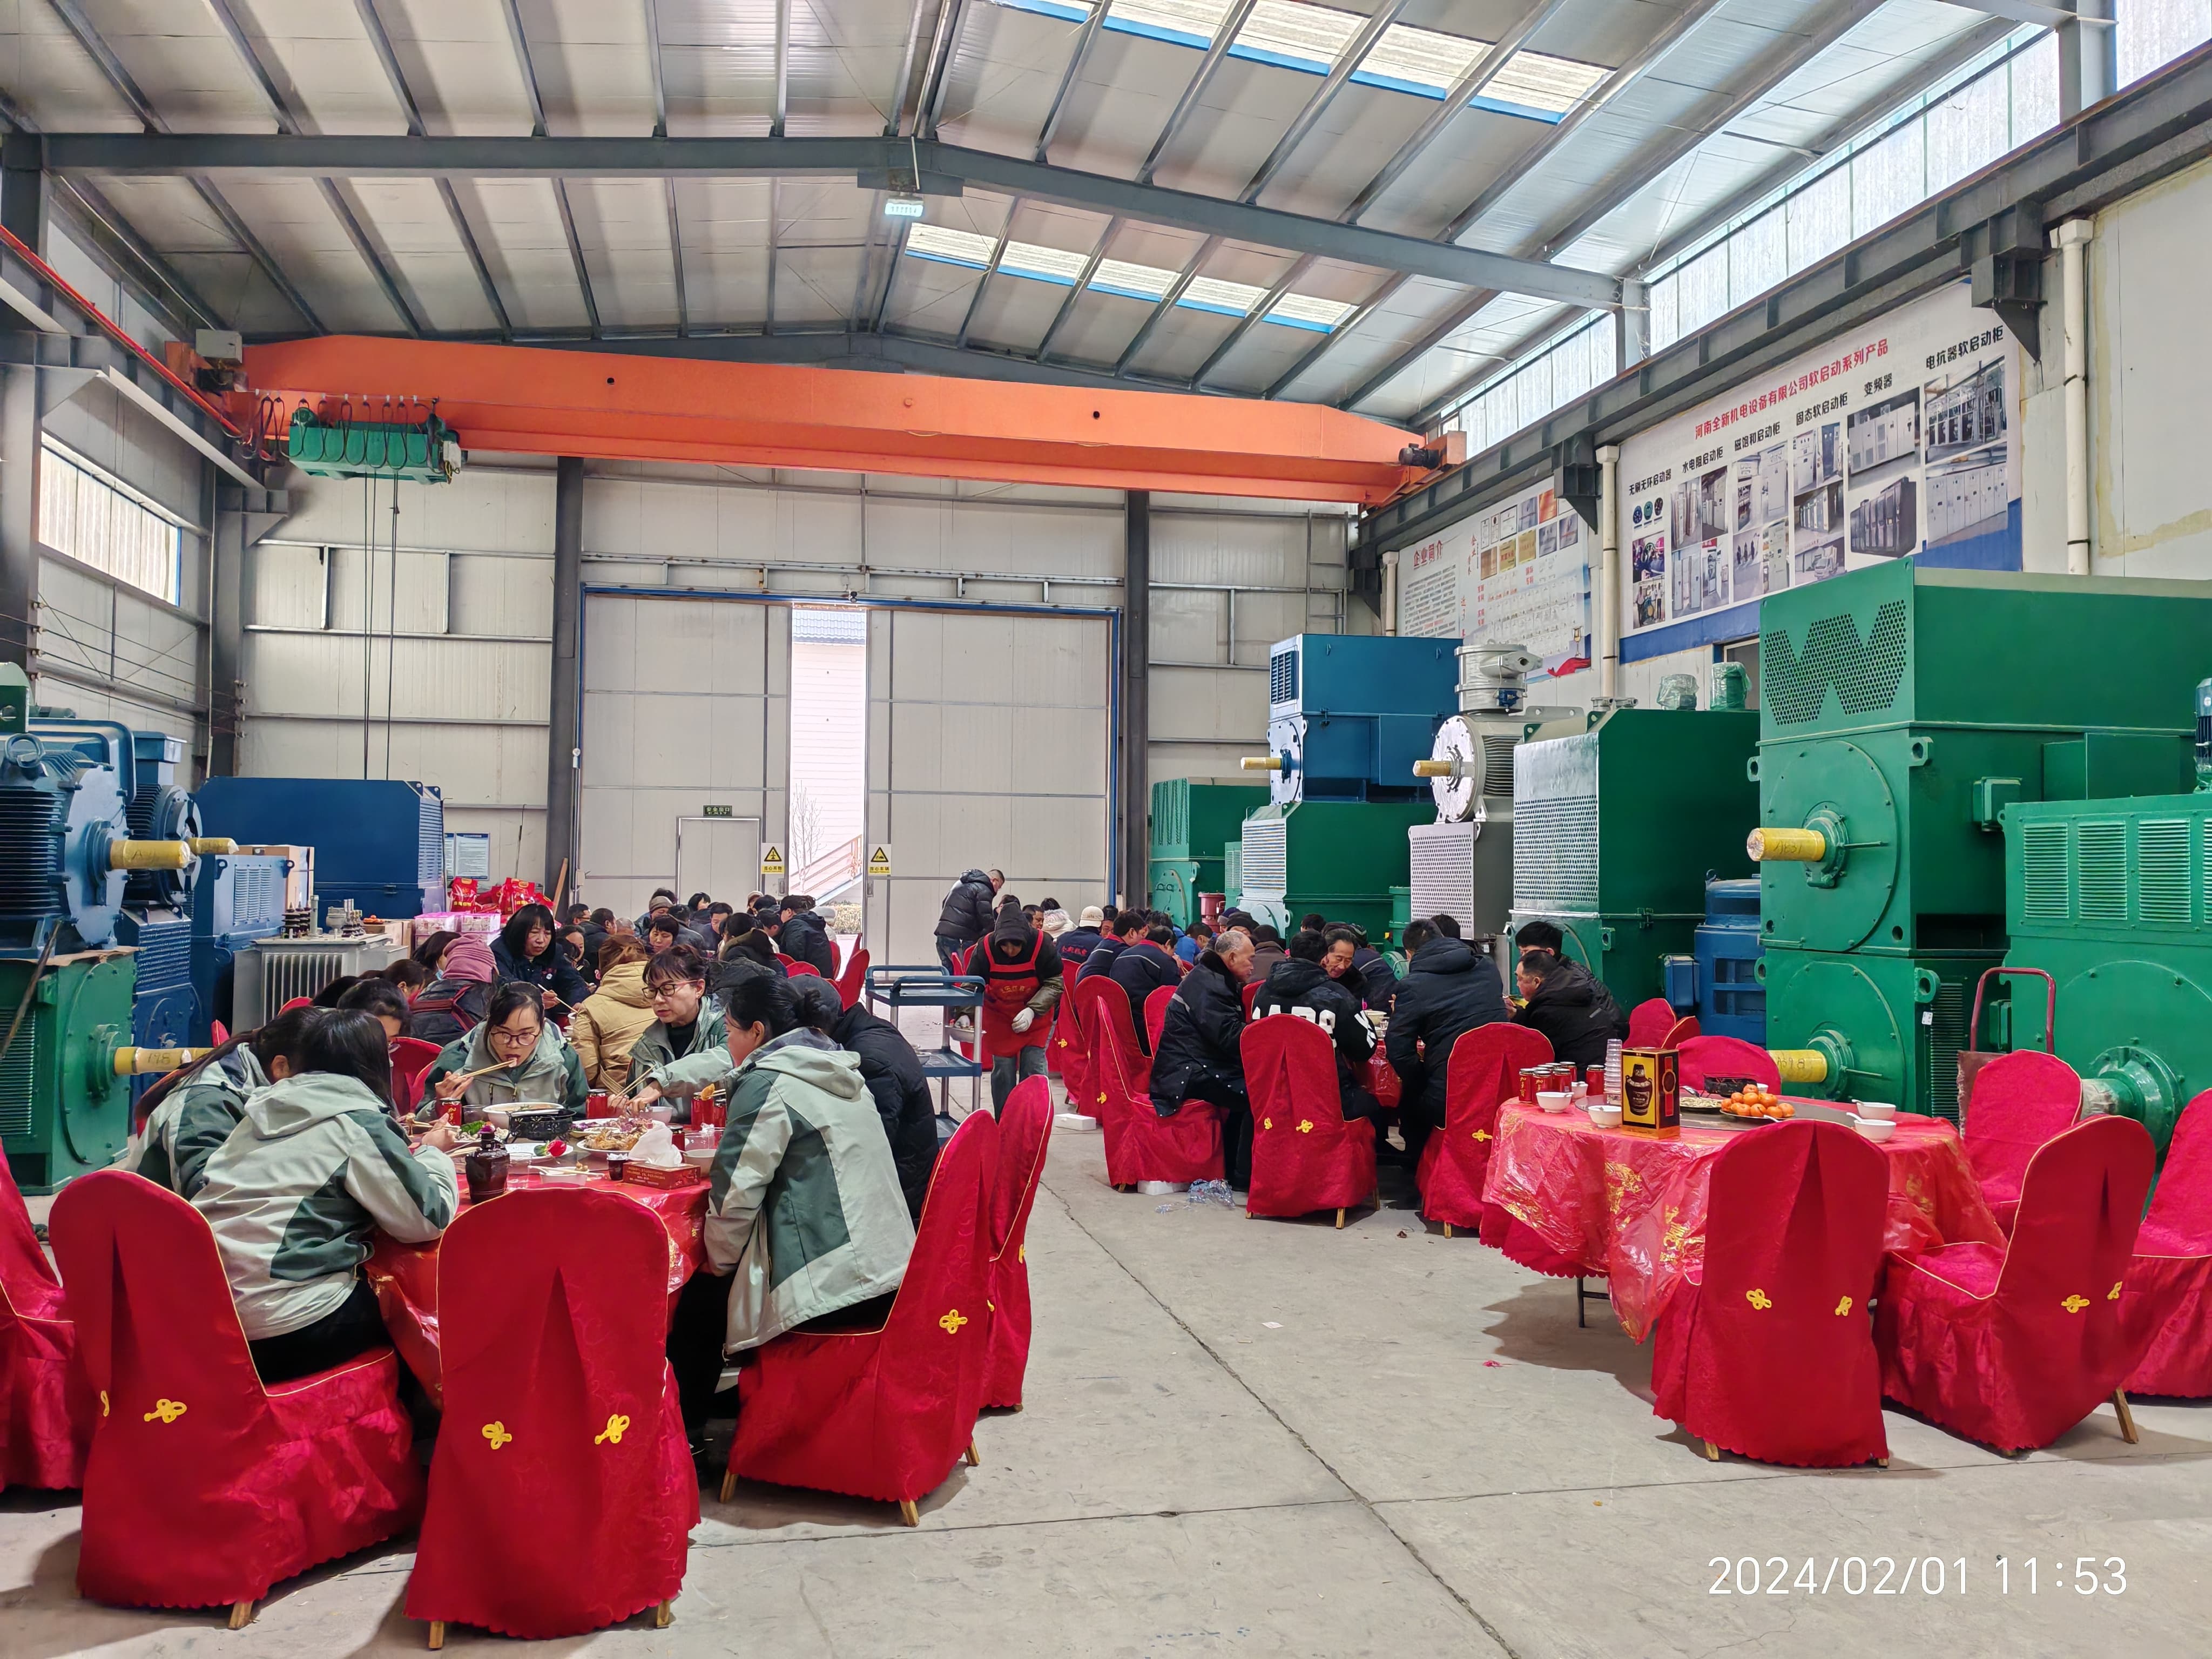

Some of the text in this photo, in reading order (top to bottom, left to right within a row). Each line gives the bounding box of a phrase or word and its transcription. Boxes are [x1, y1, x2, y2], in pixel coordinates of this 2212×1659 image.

[1926, 325, 2004, 370] 电抗器软启动柜
[1695, 339, 1889, 440] 河南全新机电设备有限公司软启动系列产品
[1864, 373, 1893, 397] 变频器
[1796, 392, 1848, 426] 固态软启动柜
[1735, 421, 1781, 451] 磁饱和启动柜
[1682, 446, 1723, 473] 水电阻启动柜
[1629, 469, 1672, 495] 无刷无环启动器
[1413, 540, 1443, 567] 企业简介
